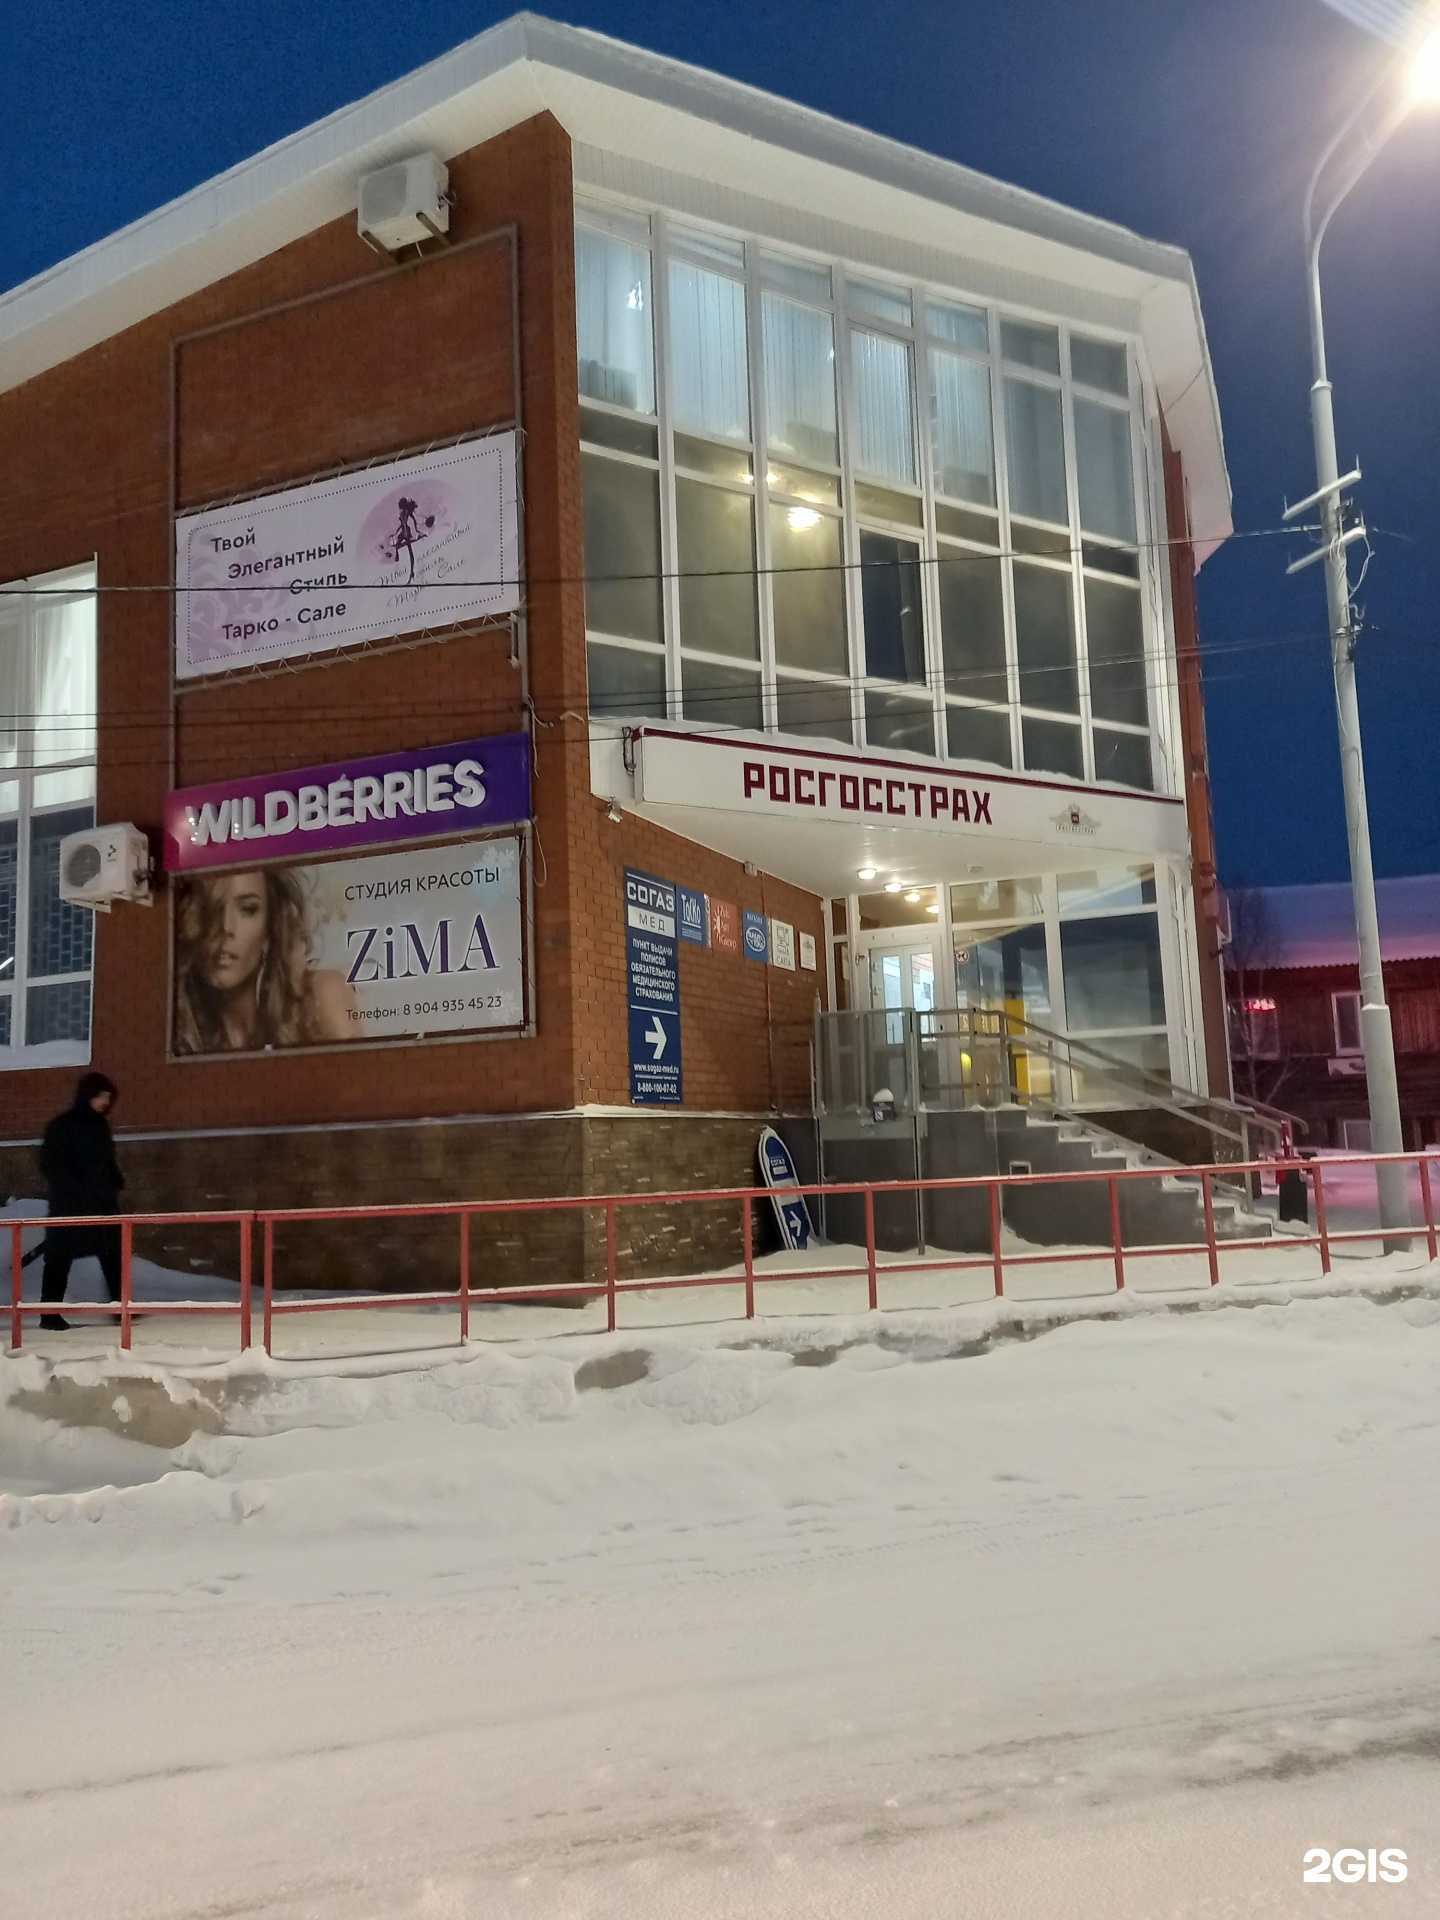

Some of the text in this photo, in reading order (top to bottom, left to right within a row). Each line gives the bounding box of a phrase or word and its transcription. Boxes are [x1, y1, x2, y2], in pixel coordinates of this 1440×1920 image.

[211, 527, 256, 553] Твой
[228, 536, 345, 580] Элегантный
[290, 571, 348, 595] Стиль
[222, 617, 279, 641] Тарко
[297, 602, 347, 624] Сале
[743, 762, 992, 825] РОСГОССТРАХ
[344, 867, 500, 901] СТУДИЯ КРАСОТЫ
[626, 881, 675, 912] СОГАЗ
[639, 913, 665, 932] МЕД
[346, 914, 500, 983] ZiMA
[632, 938, 650, 951] ПУНКТ
[631, 961, 676, 980] ОБЯЗАТЕЛЬНОГО
[640, 952, 667, 966] ПОЛИСОВ
[632, 974, 676, 991] МЕДИЦИНСКОГО
[635, 987, 674, 1002] СТРАХОВАНИЯ
[346, 996, 502, 1021] Телефон: 8 904 935 45 23
